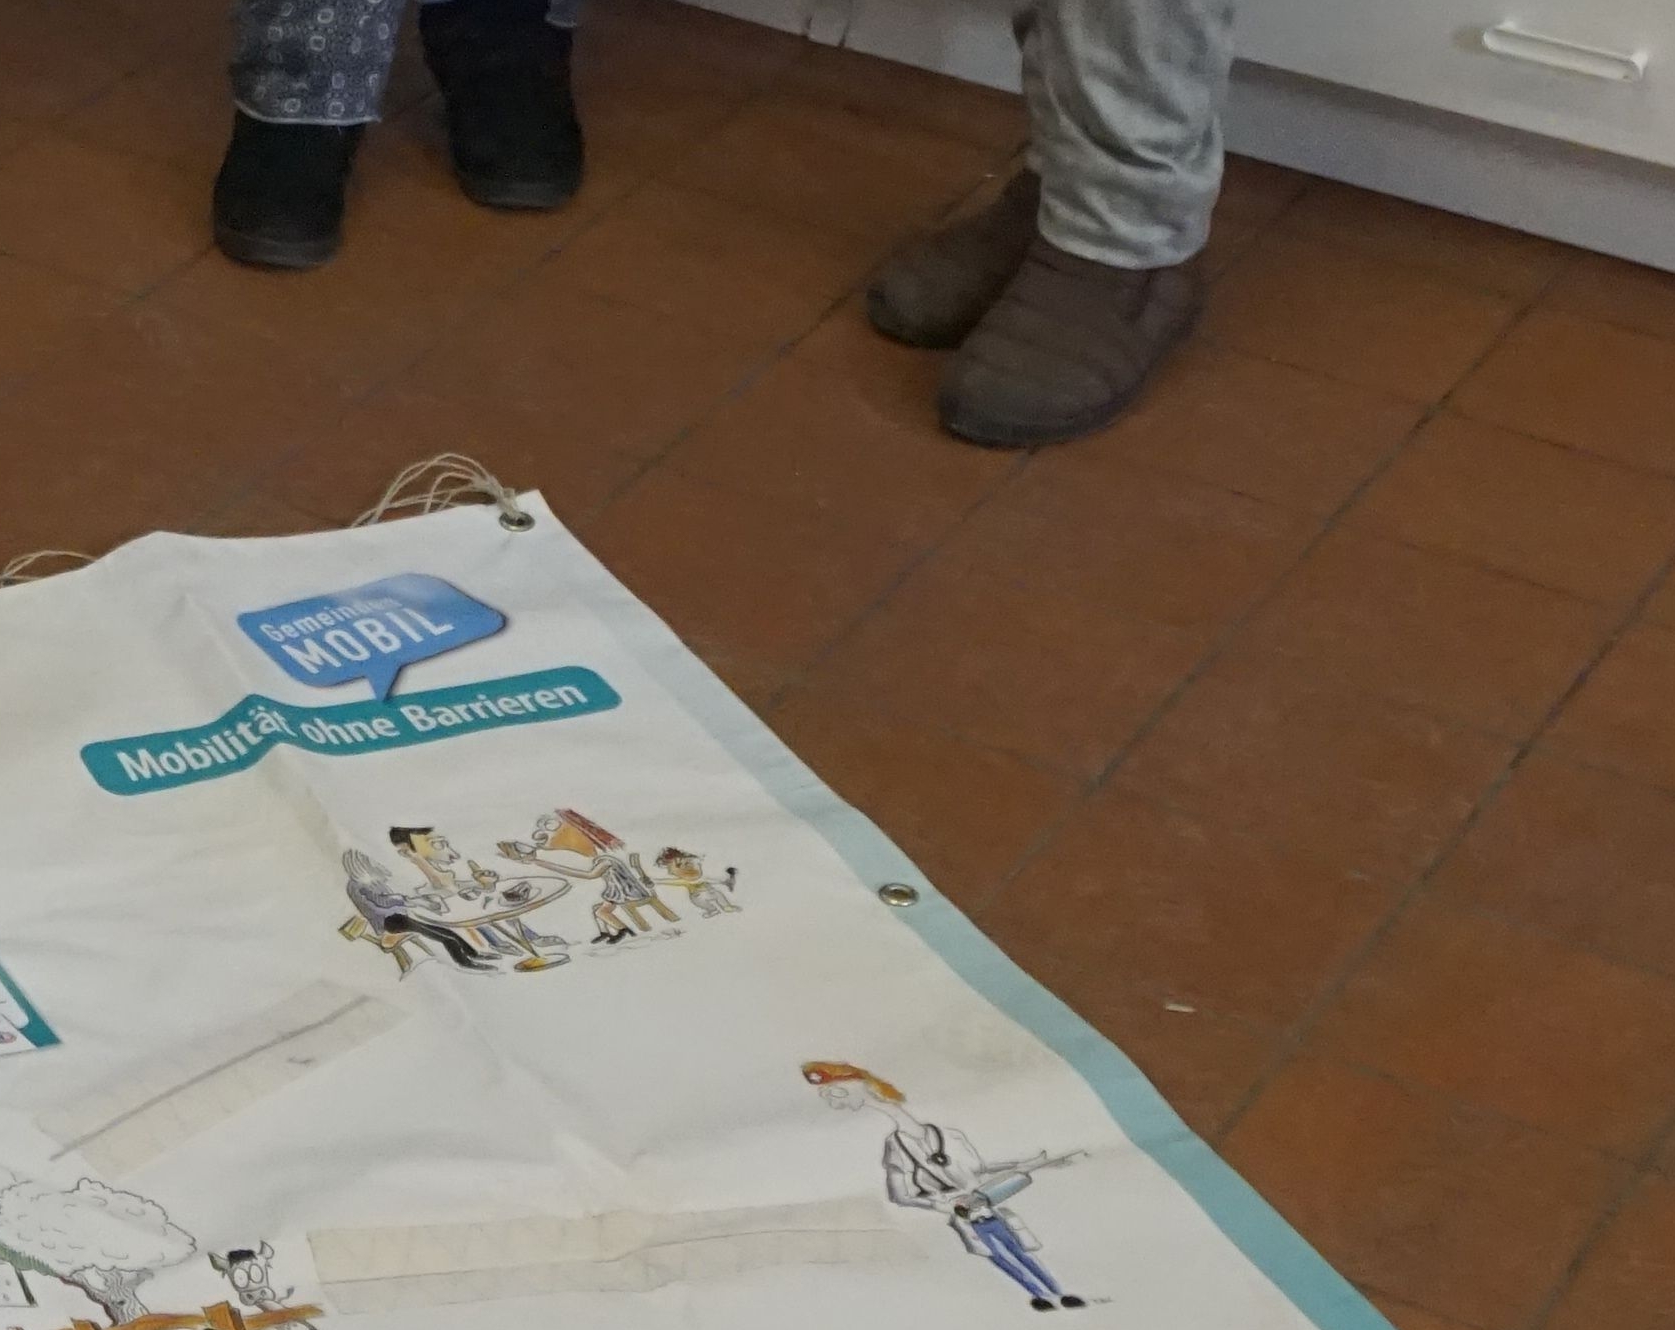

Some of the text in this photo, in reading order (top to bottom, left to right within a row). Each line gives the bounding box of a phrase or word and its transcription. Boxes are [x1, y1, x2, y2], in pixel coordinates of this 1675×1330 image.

[281, 607, 455, 675] MOBIL
[116, 684, 588, 782] Mobilität ohne Barrieren
